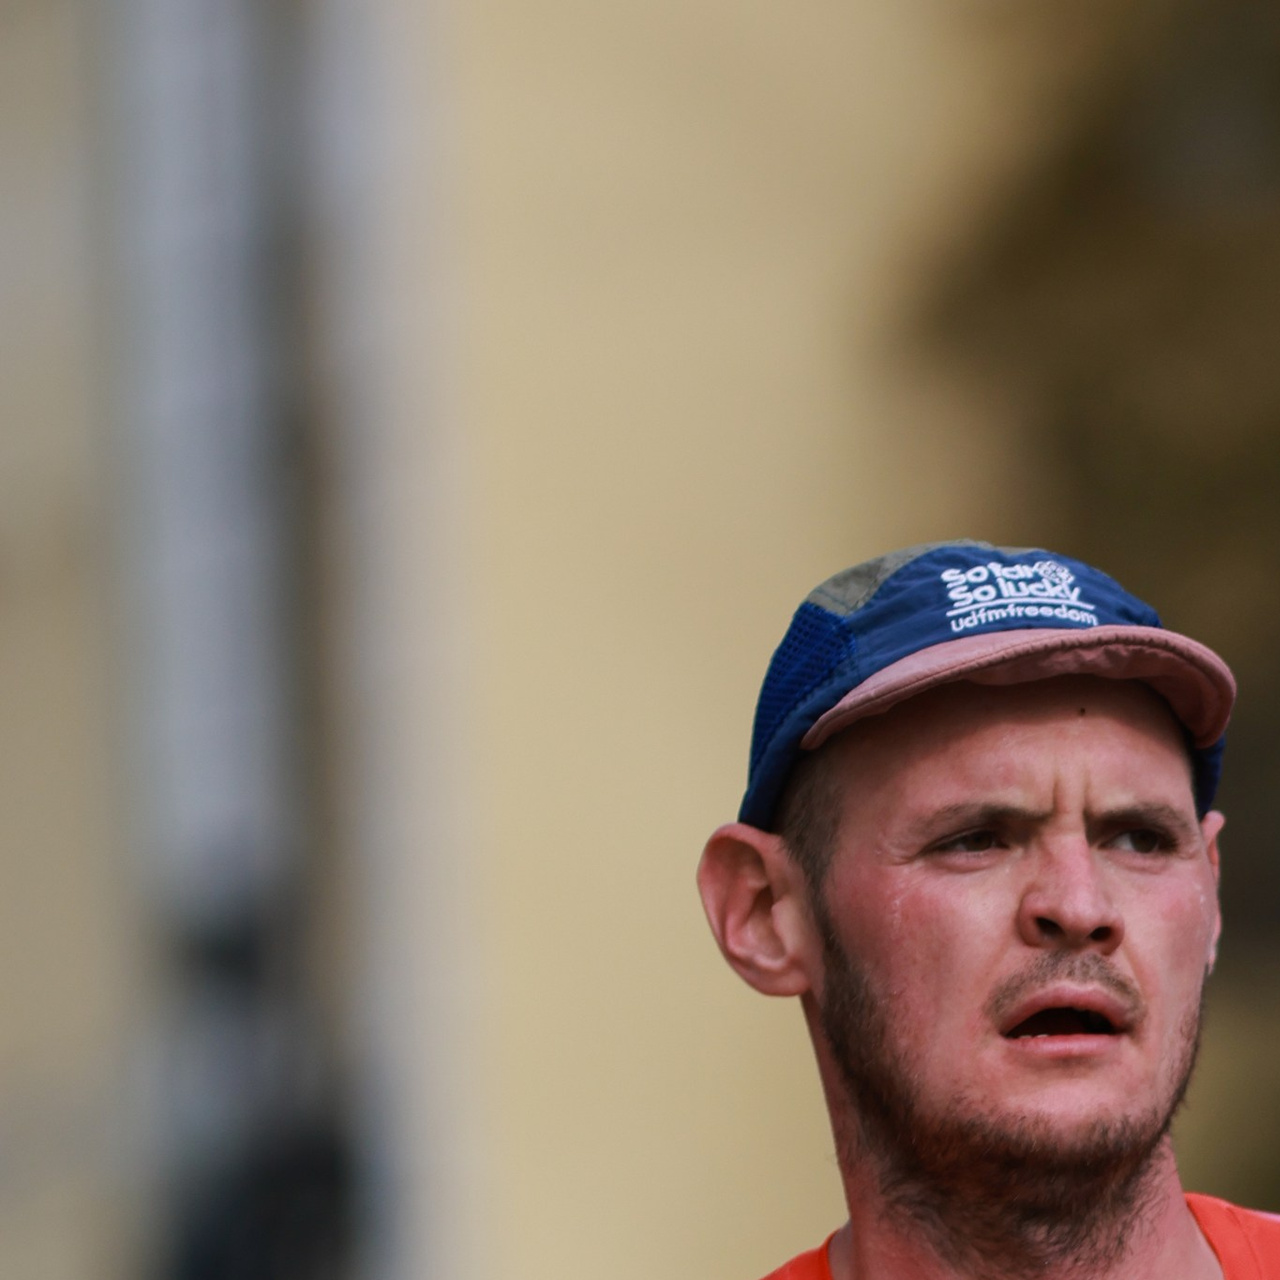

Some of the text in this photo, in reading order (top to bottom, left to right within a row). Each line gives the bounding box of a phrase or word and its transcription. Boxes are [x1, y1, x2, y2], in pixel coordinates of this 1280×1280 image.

[940, 565, 988, 589] So
[948, 577, 1080, 607] So lucky
[951, 603, 1098, 632] udfmfreedom
